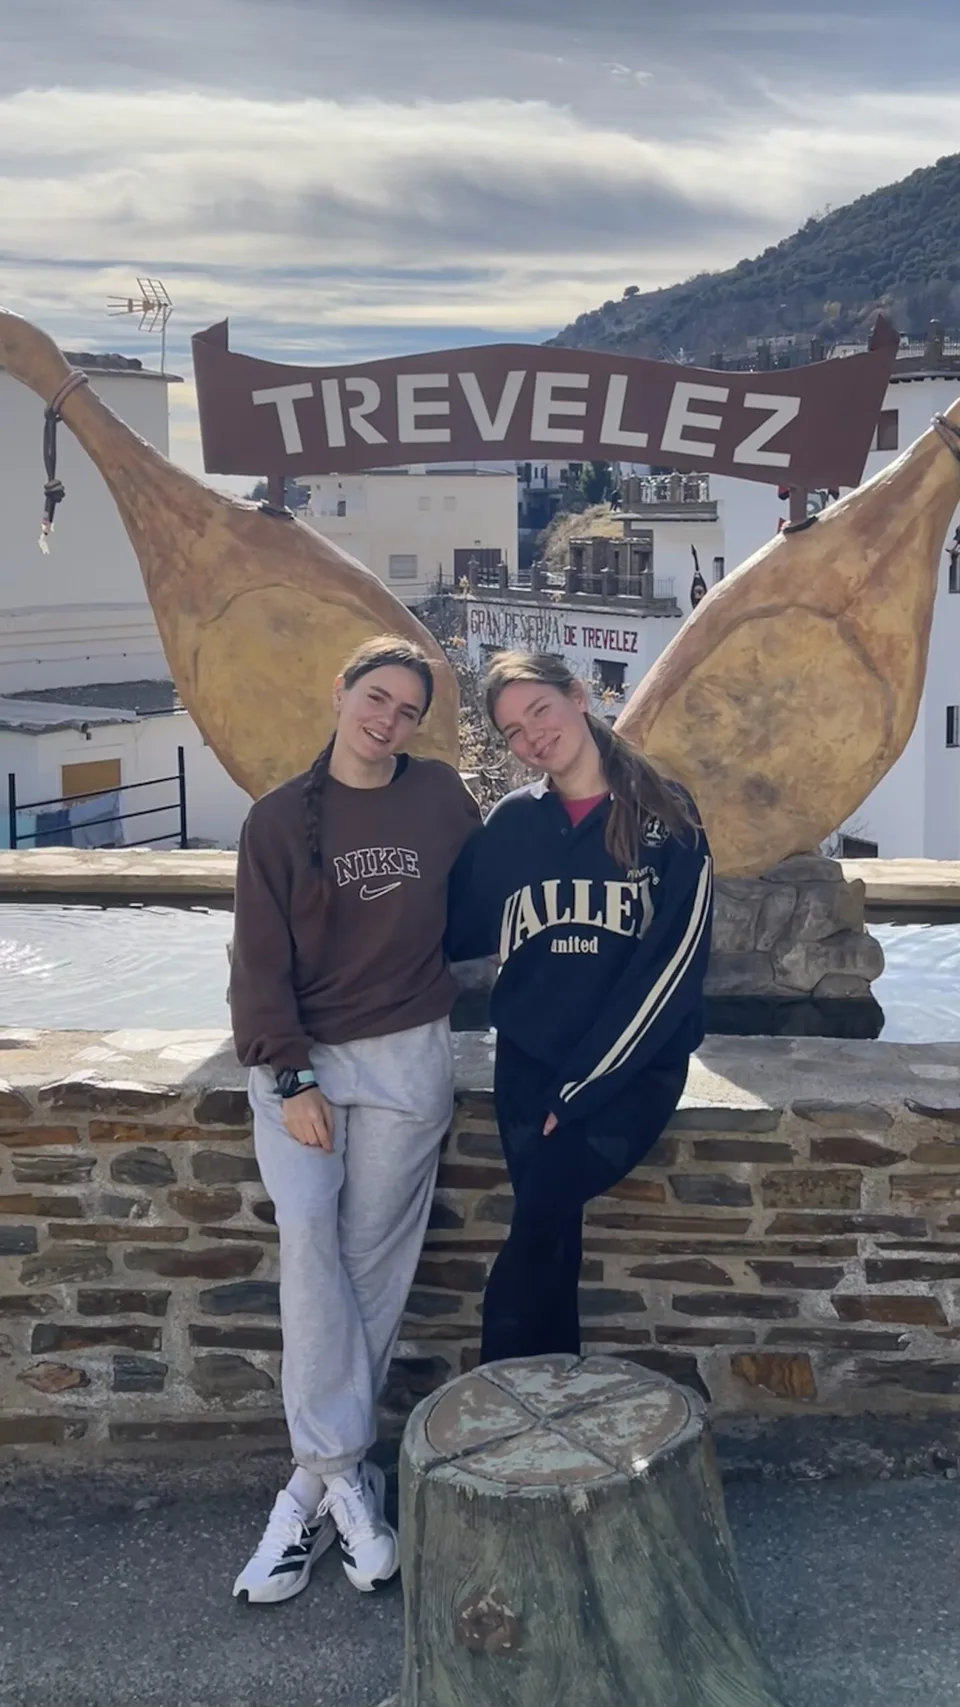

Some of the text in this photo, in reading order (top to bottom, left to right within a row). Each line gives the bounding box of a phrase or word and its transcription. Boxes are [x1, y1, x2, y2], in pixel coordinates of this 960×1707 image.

[252, 370, 802, 468] TREVELEZ
[470, 609, 501, 642] GRAN
[563, 624, 577, 646] DE
[582, 627, 638, 653] TREVELEZ
[333, 847, 420, 887] NIKE
[551, 935, 598, 954] united
